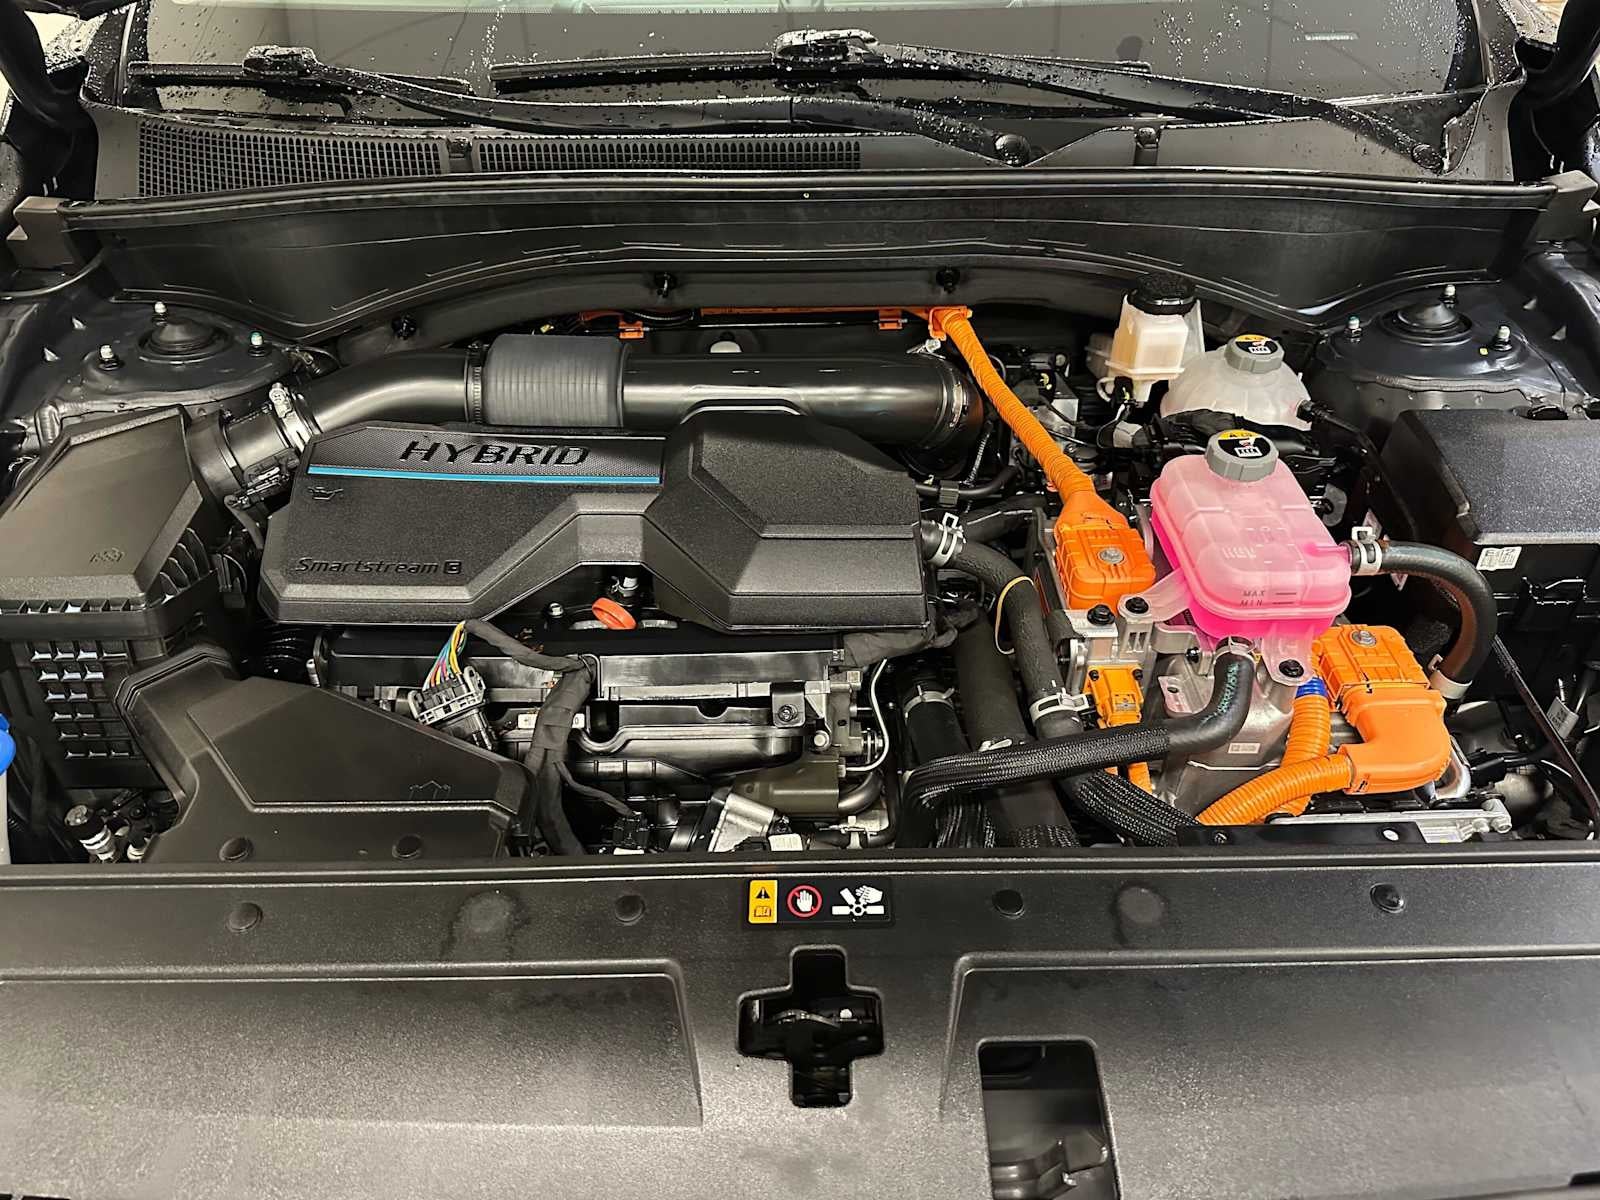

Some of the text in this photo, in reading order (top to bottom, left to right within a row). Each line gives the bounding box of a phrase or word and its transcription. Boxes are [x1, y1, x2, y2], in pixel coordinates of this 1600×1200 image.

[399, 440, 591, 466] HYBRID
[296, 556, 439, 574] Smartstream
[1240, 599, 1262, 607] MIN
